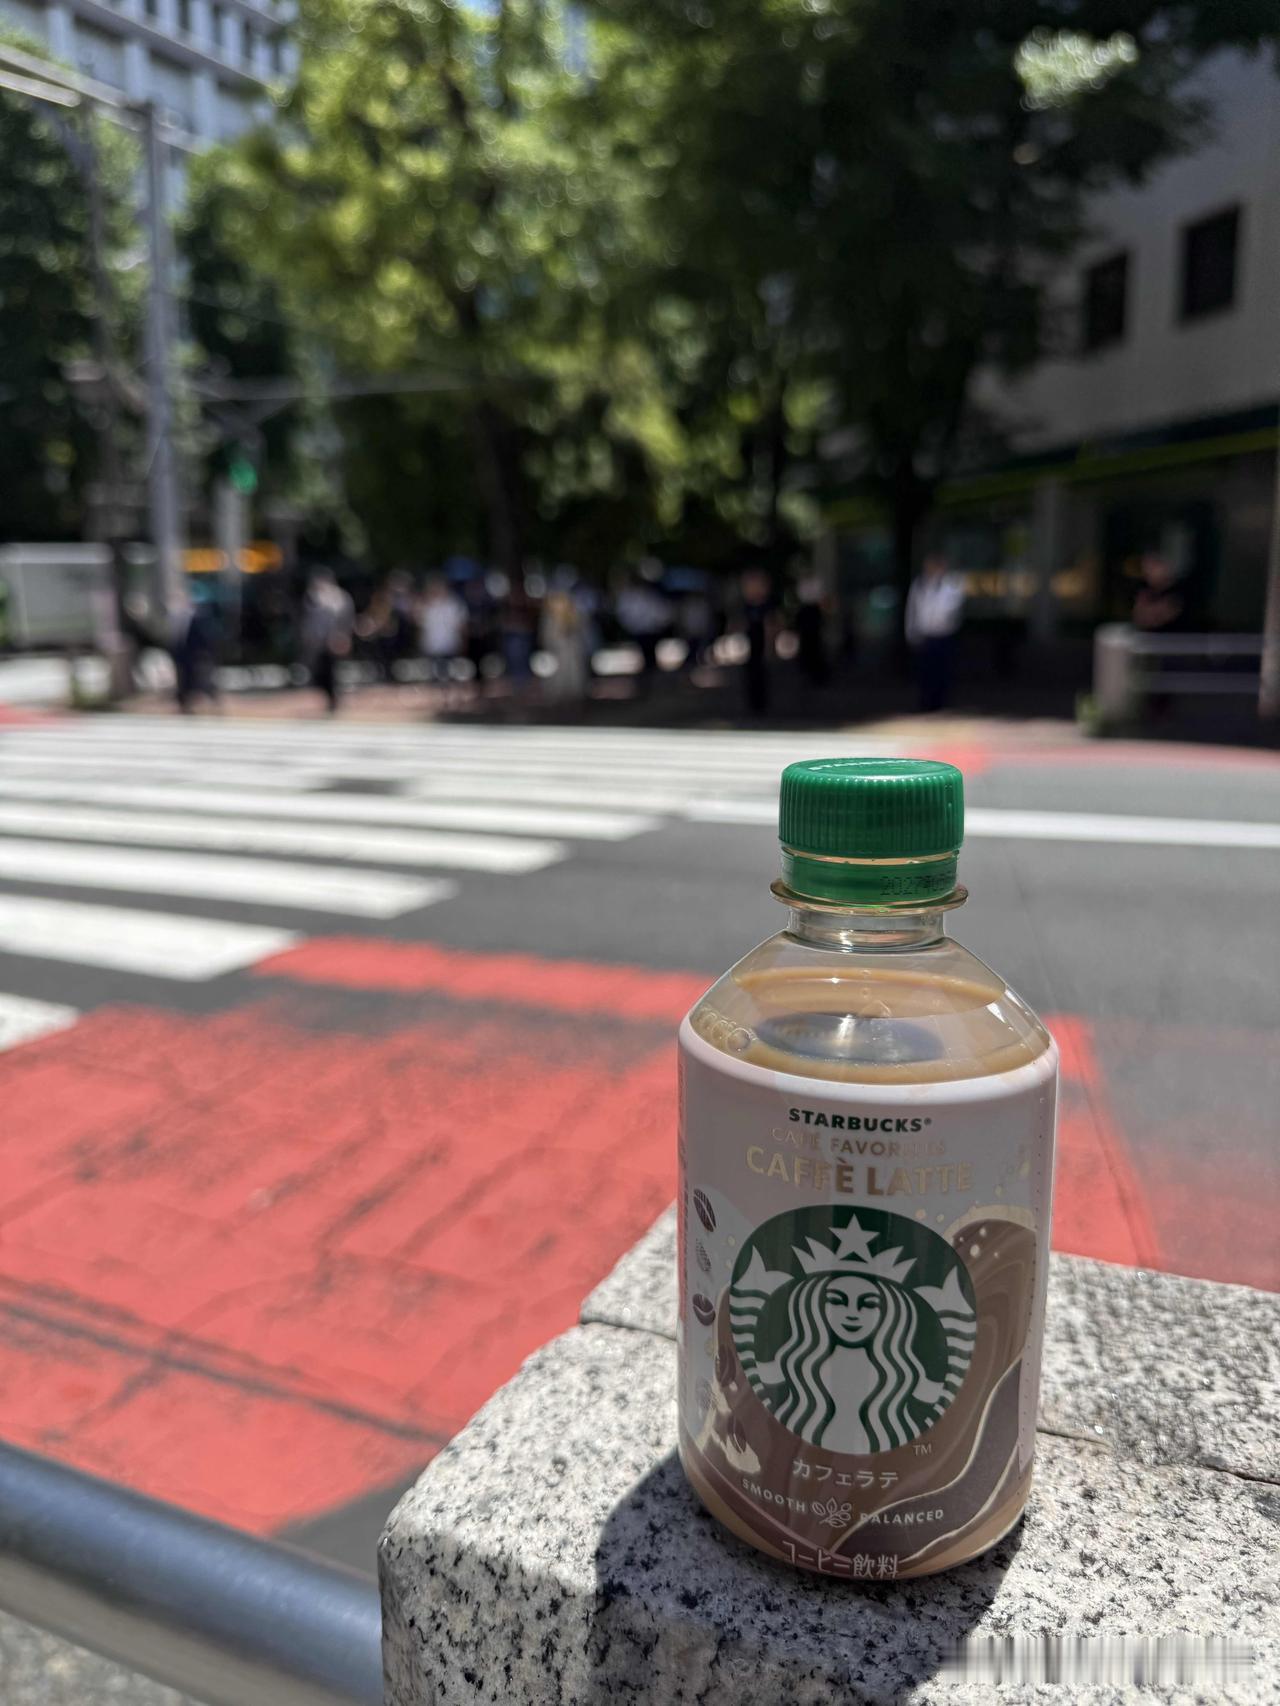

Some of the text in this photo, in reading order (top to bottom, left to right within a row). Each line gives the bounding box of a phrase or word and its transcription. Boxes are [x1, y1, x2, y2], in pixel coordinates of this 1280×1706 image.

[746, 1145, 976, 1197] CAFFÈ LATTE
[792, 1459, 899, 1489] カフェラテ
[741, 1478, 944, 1526] SMOOTH BALANCED
[781, 1540, 899, 1580] コーヒー飲料
